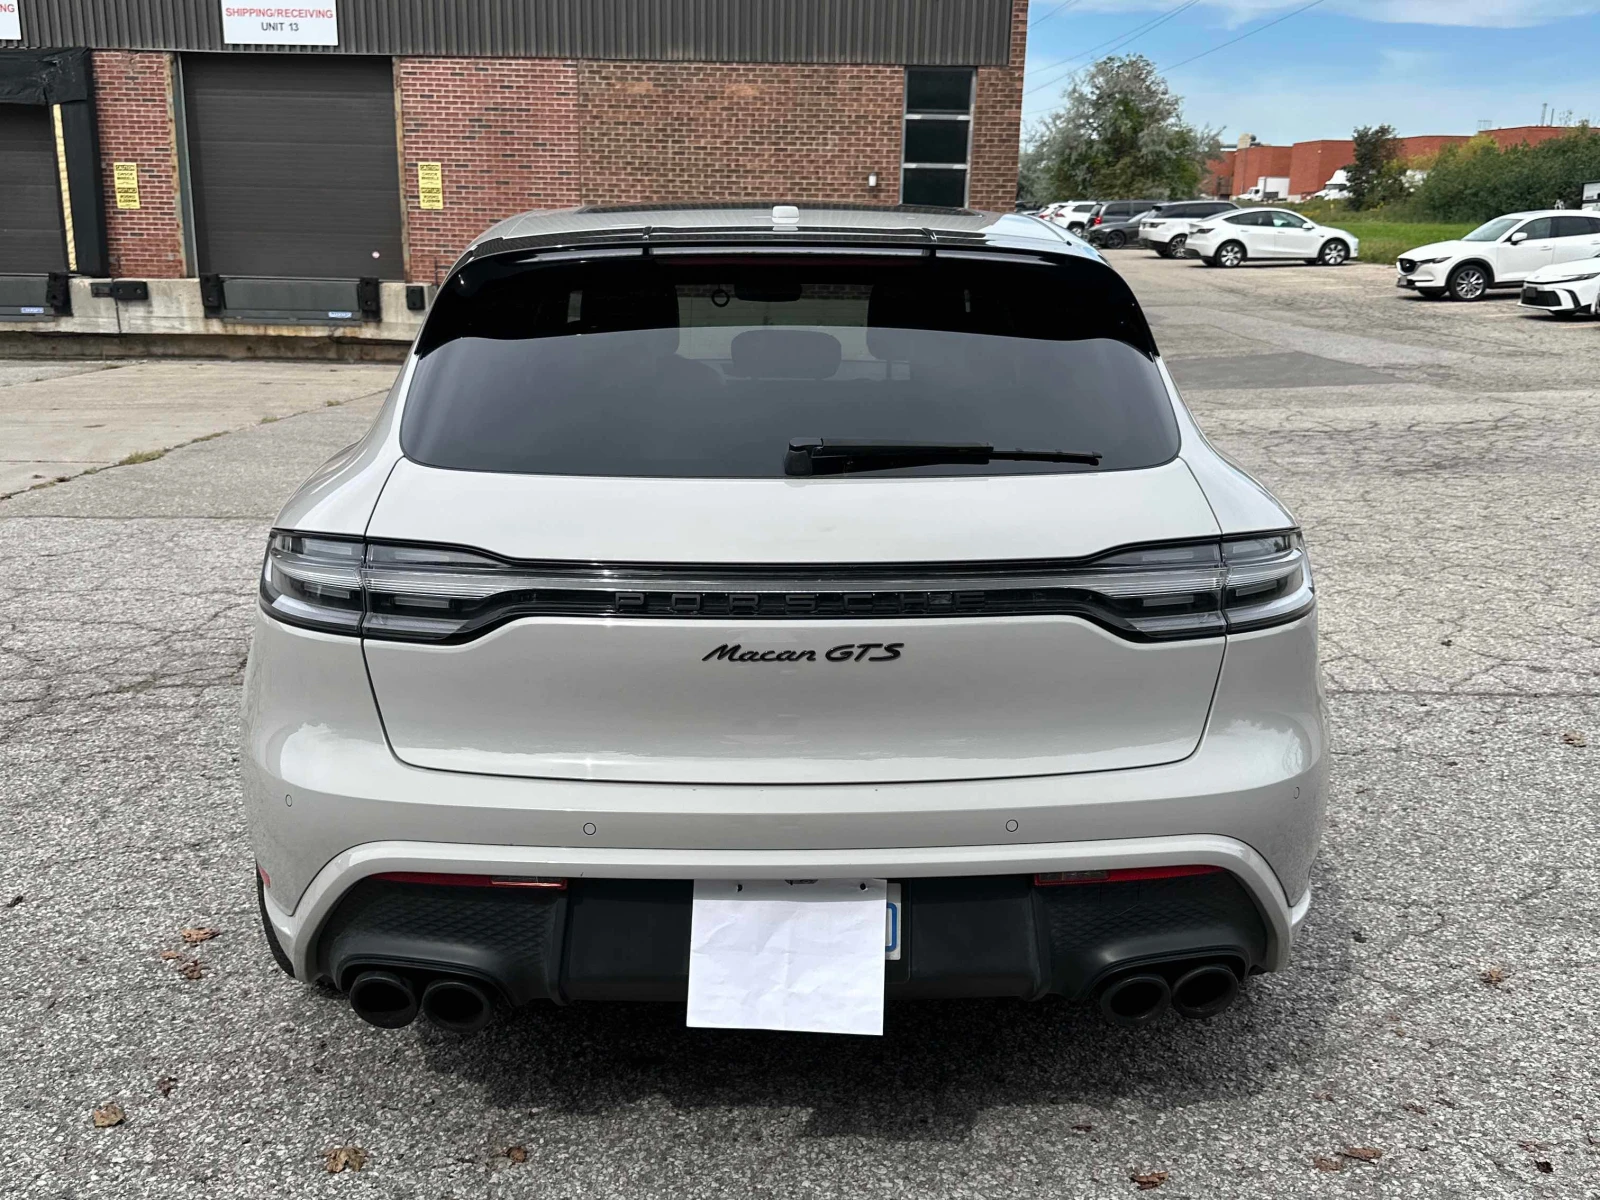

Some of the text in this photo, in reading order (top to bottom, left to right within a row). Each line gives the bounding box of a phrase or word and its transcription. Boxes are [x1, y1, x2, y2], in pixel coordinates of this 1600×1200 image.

[225, 7, 334, 19] SHIPPING/RECEIVING
[261, 22, 300, 32] UNIT 13
[615, 591, 986, 613] PORSCHE
[701, 642, 905, 663] Macan GTS
